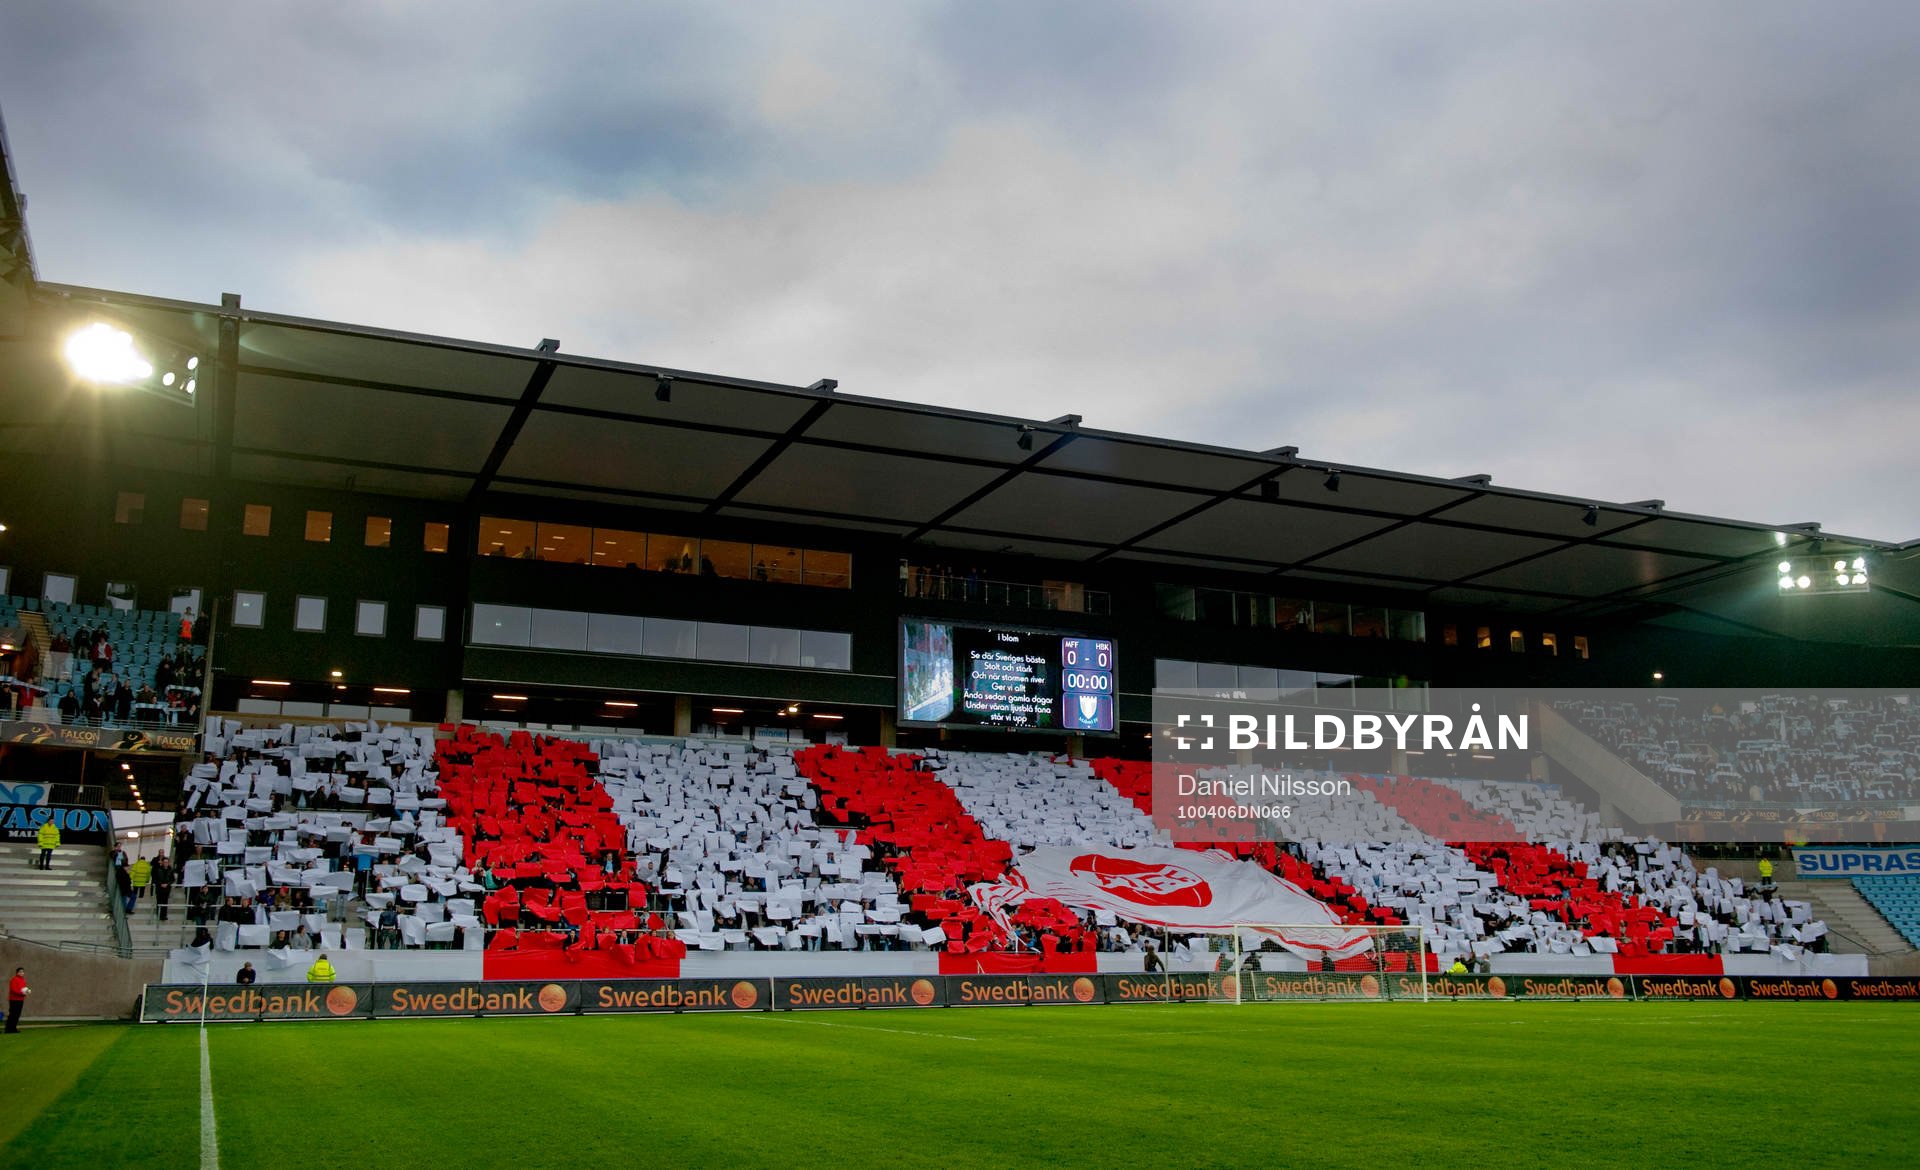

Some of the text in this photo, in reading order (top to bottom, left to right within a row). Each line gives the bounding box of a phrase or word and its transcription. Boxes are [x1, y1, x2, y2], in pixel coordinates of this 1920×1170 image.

[997, 633, 1020, 643] i blom
[1095, 643, 1109, 651] HBK
[970, 650, 1046, 664] Se där Sveriges bästa
[1067, 651, 1076, 665] 0
[1098, 653, 1107, 667] 0
[984, 662, 1033, 673] Stolt och stark
[971, 671, 1045, 684] Och när stormen river
[1067, 673, 1108, 690] 00:00
[991, 682, 1026, 692] Ger vi allt
[963, 688, 1053, 705] Ända sedan gamla dagar
[990, 713, 1005, 721] står
[1006, 713, 1012, 721] vi
[1012, 715, 1027, 725] upp
[60, 728, 99, 741] FALCON
[156, 735, 196, 746] FALCON
[789, 983, 907, 1004] Swedbank
[961, 980, 1070, 1001] Swedbank
[1119, 979, 1219, 998] Swedbank
[1266, 977, 1358, 996] Swedbank
[1399, 977, 1485, 996] Swedbank
[1524, 978, 1605, 996] Swedbank
[1644, 979, 1718, 997] Swedbank
[1750, 979, 1822, 997] Swedbank
[1851, 980, 1919, 996] Swedbank
[166, 990, 320, 1015] Swedbank
[392, 988, 533, 1012] Swedbank
[599, 985, 727, 1008] Swedbank
